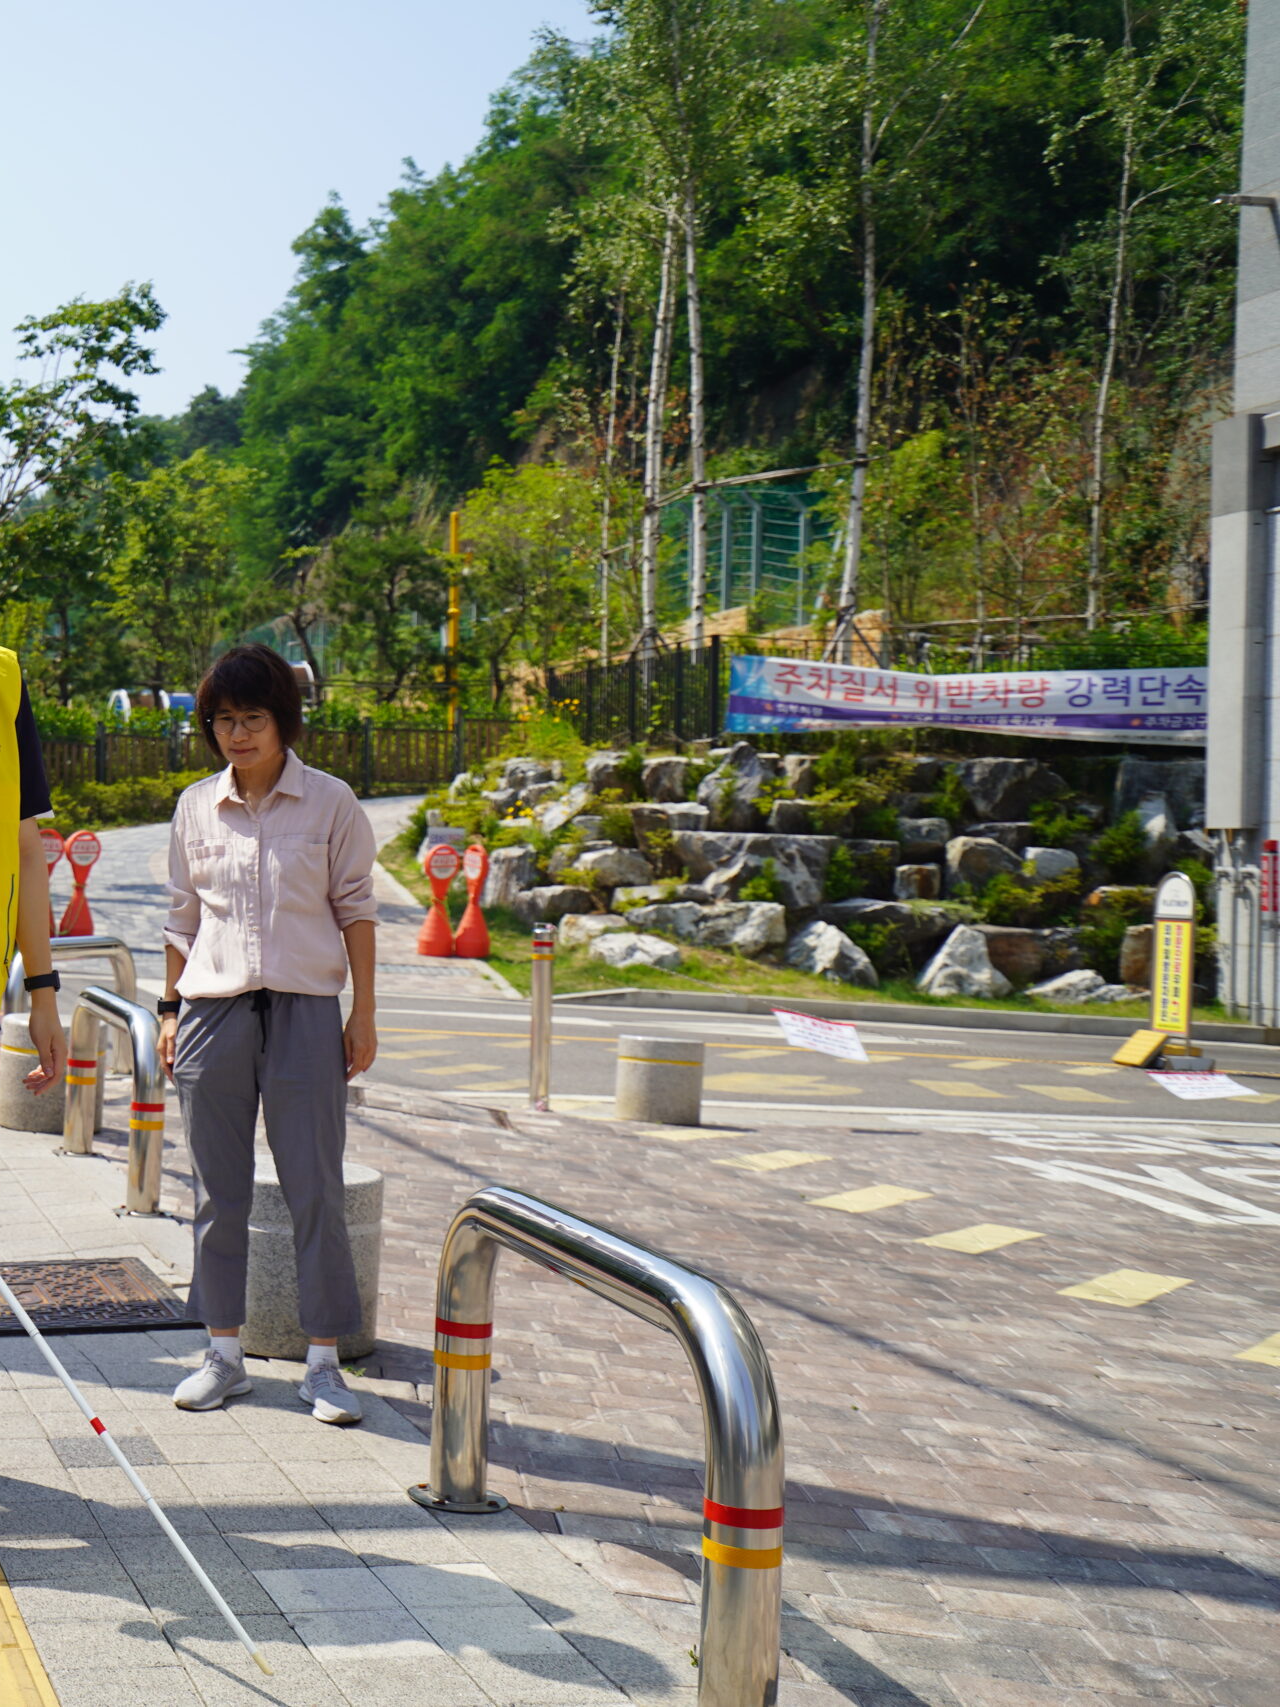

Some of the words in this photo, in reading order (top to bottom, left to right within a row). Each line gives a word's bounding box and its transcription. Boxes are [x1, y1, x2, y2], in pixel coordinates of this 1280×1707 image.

[773, 663, 899, 706] 주차질서
[912, 677, 1052, 709] 위반차량
[1065, 673, 1207, 708] 강력단속
